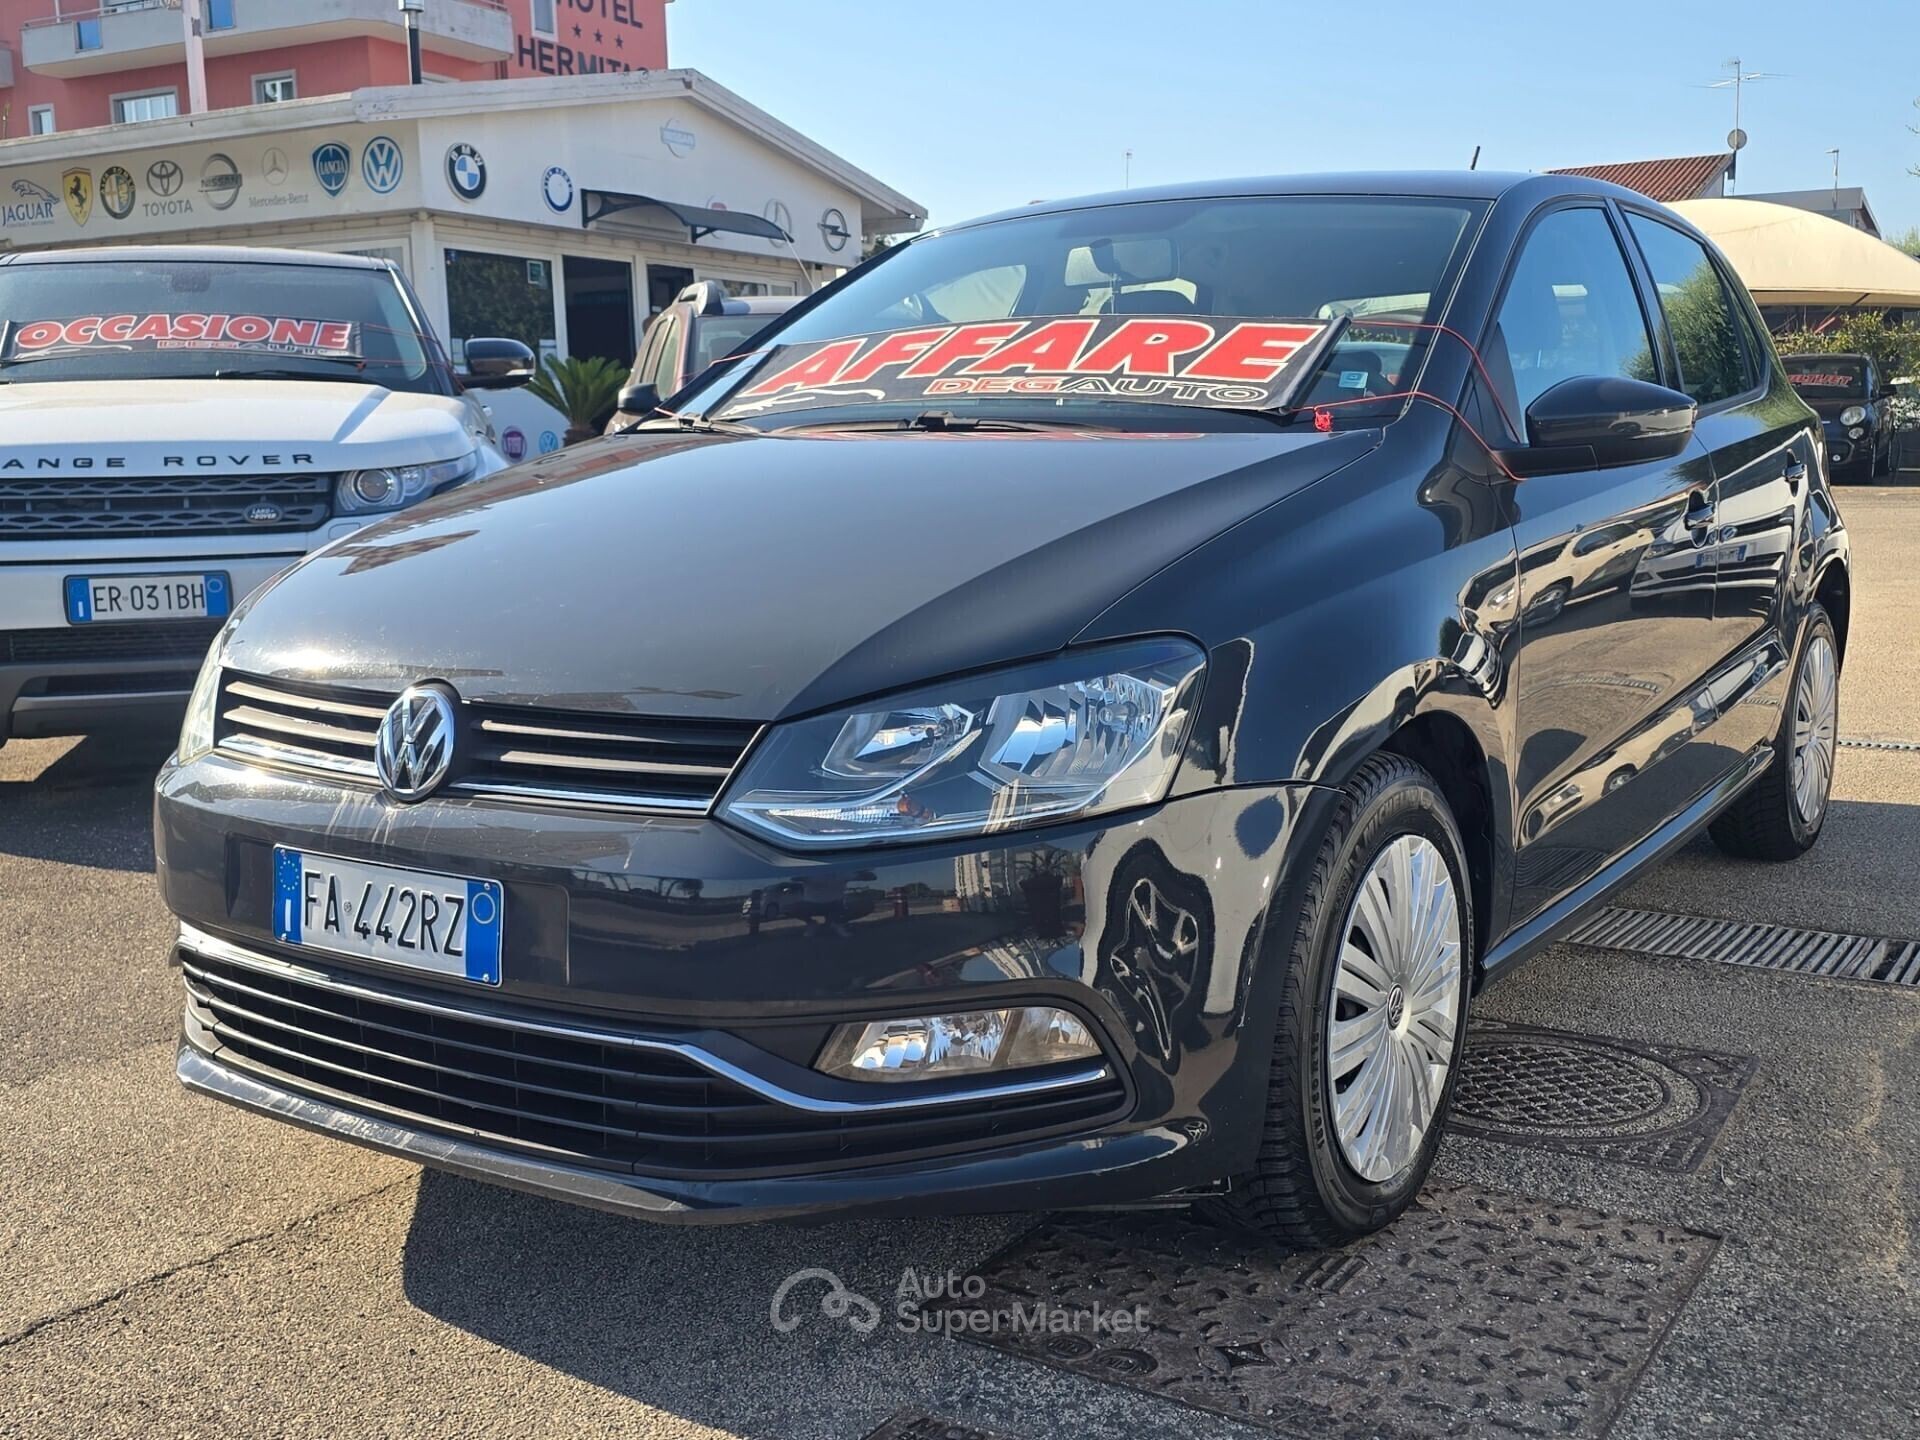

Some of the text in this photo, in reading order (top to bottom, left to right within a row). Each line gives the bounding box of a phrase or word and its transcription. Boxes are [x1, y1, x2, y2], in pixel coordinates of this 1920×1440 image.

[2, 202, 54, 227] JAGUAR
[142, 199, 194, 217] TOYOTA
[14, 313, 354, 349] OCCASIONE
[741, 318, 1327, 398] AFFARE
[164, 454, 314, 467] ROVER
